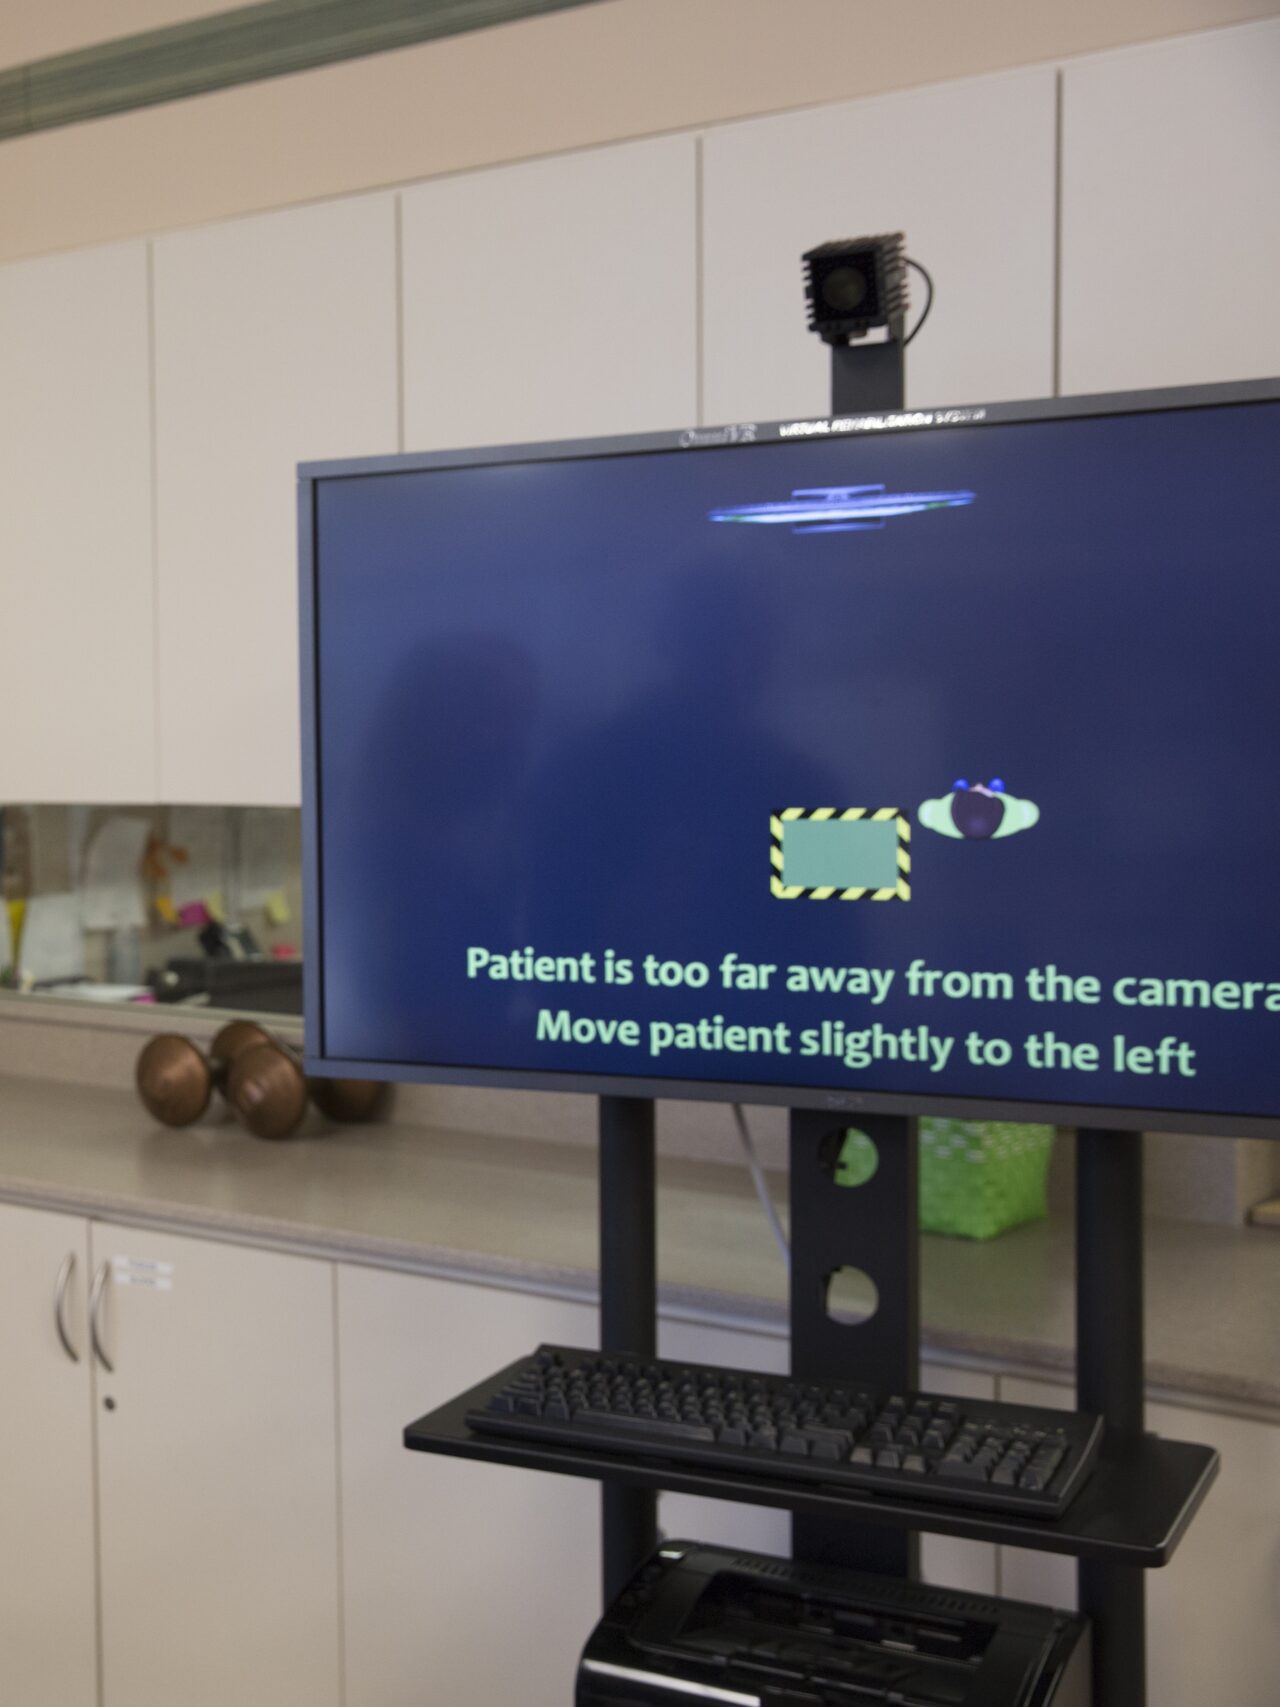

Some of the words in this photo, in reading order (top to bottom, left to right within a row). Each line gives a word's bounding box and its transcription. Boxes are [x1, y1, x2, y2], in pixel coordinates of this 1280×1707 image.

[466, 945, 597, 984] Patient
[604, 948, 634, 985] is
[642, 954, 710, 988] too
[718, 952, 778, 990] far
[786, 965, 895, 1005] away
[904, 959, 1014, 1000] from
[1025, 964, 1101, 1004] the
[1112, 977, 1280, 1012] camera
[536, 1008, 641, 1046] Move
[649, 1014, 792, 1057] patient
[799, 1020, 955, 1072] slightly
[964, 1031, 1012, 1066] to
[1023, 1031, 1100, 1072] the
[1113, 1034, 1197, 1077] left
